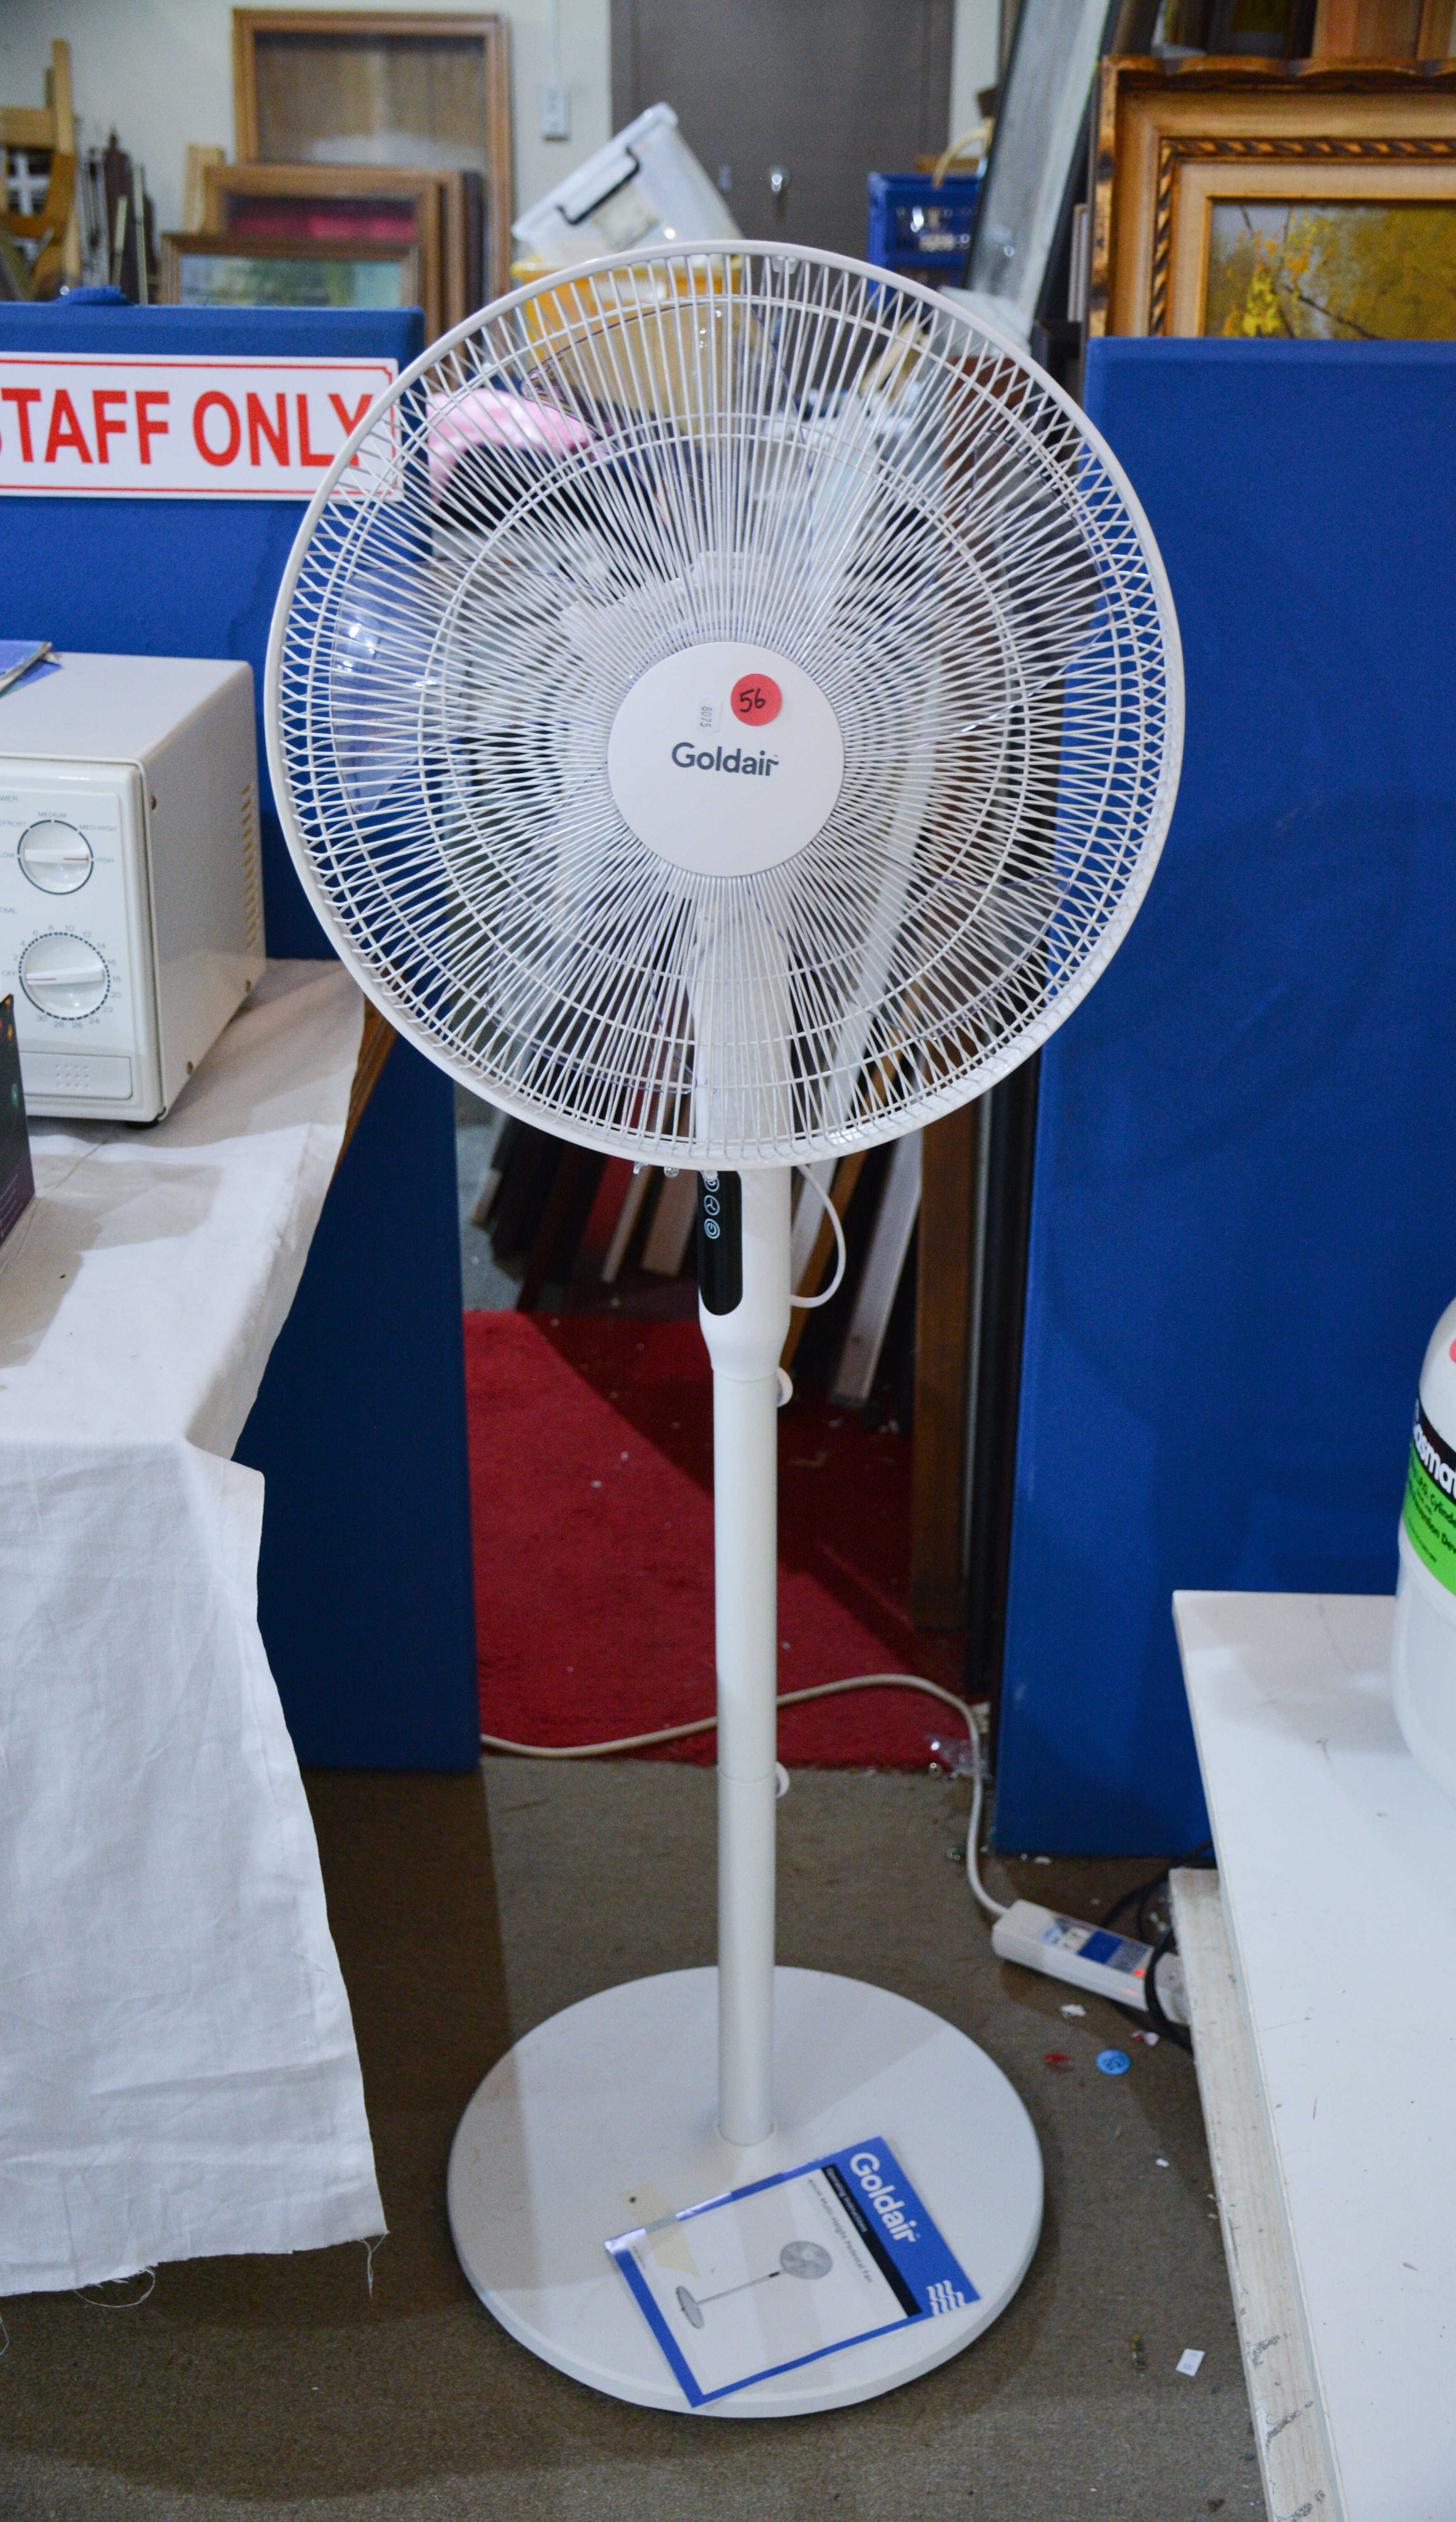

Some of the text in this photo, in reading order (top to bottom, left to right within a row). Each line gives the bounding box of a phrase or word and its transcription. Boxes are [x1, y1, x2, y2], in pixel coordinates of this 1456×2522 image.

[0, 387, 374, 467] TAFF ONLY
[739, 688, 766, 713] 56
[700, 707, 712, 727] 8075
[672, 741, 779, 777] Goldair
[825, 2166, 847, 2198] Operating
[849, 2152, 917, 2242] Goldair
[863, 2269, 873, 2283] Fan
